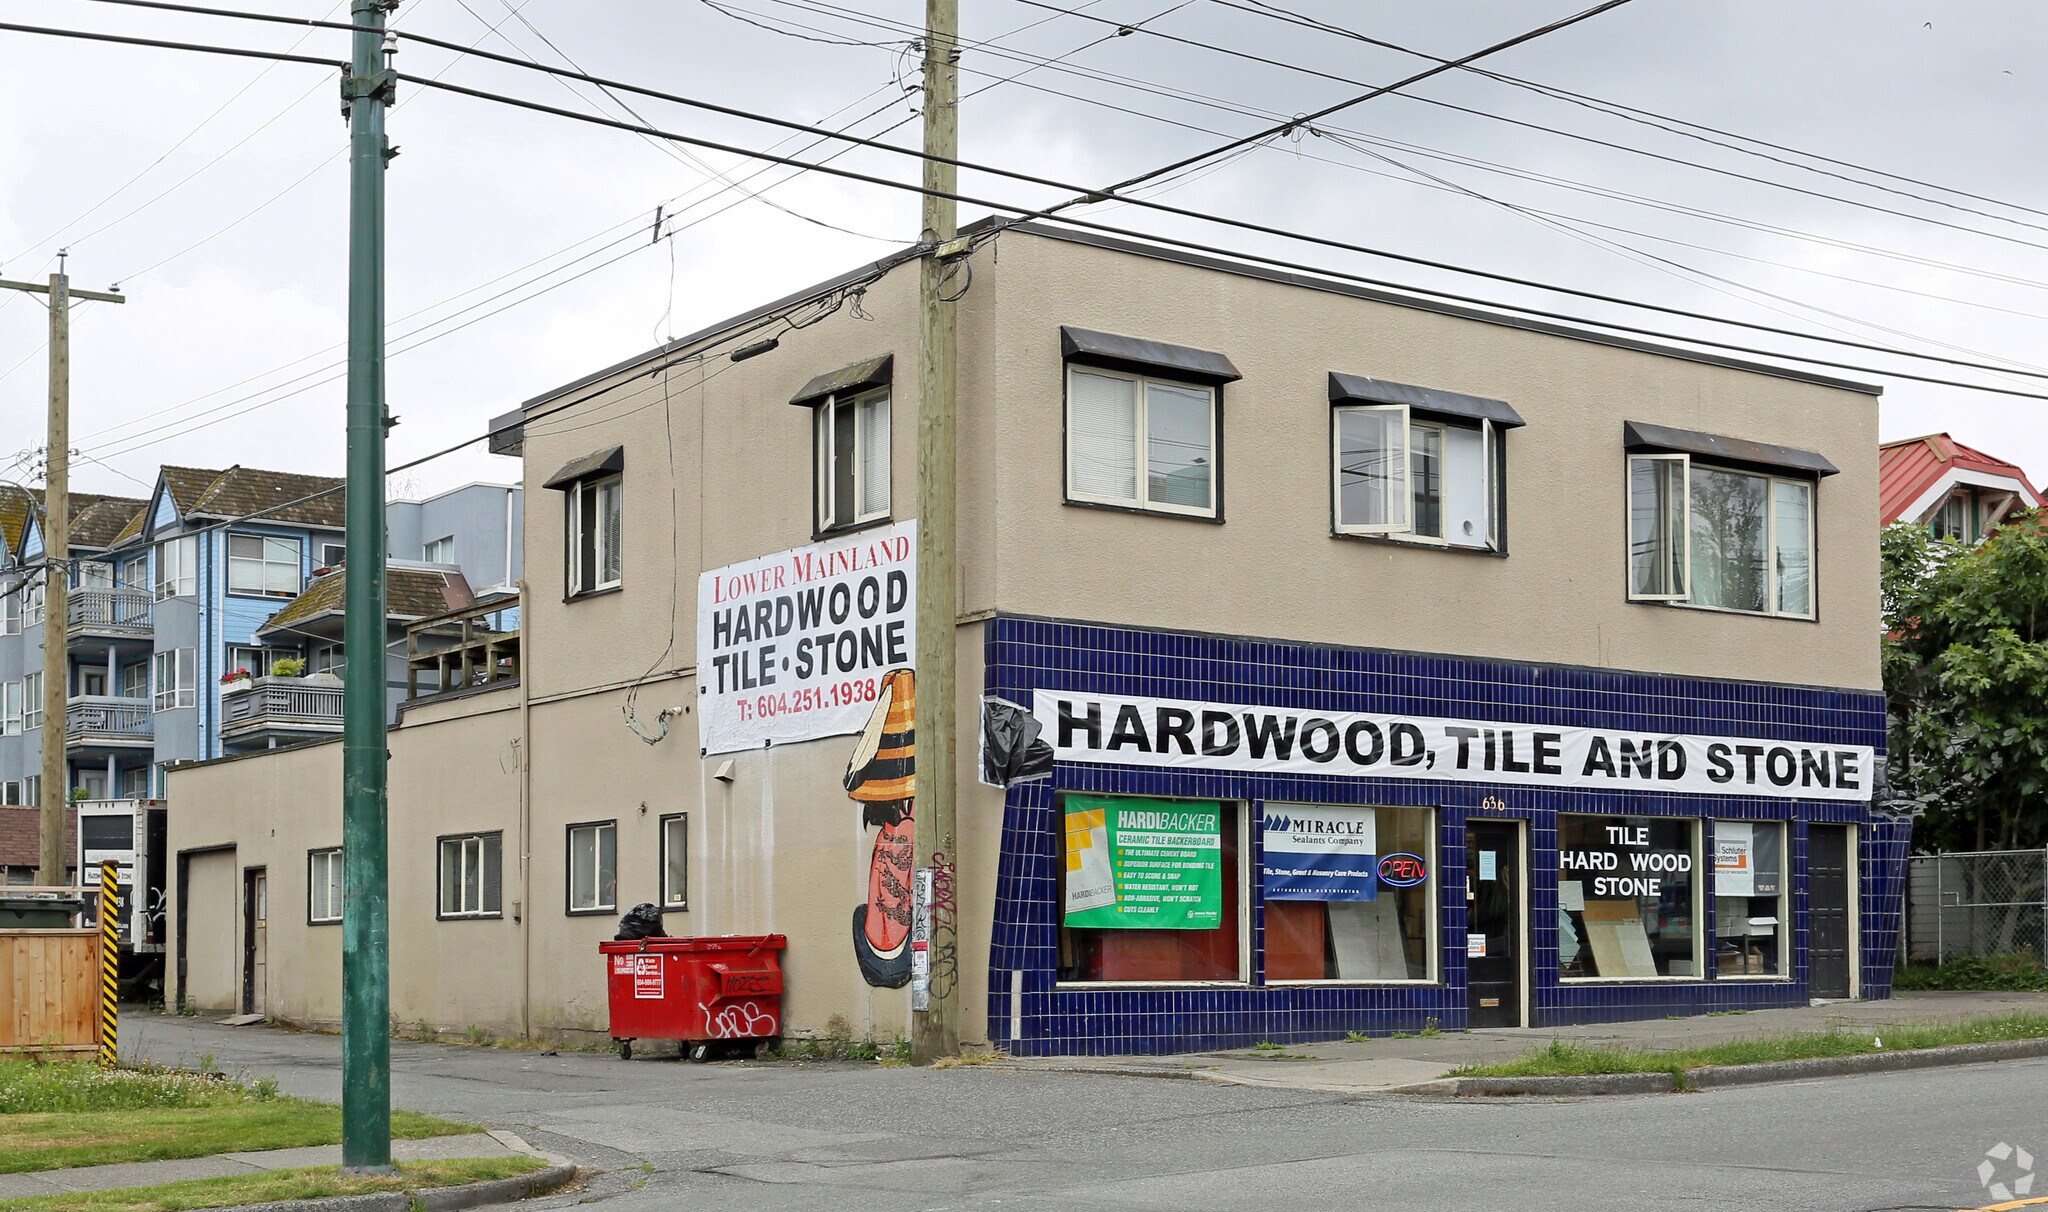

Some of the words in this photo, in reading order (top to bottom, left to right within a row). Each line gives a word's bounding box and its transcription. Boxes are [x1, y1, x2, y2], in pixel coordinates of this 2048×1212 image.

[714, 565, 785, 604] LOWER
[792, 536, 910, 585] MAINLAND
[713, 569, 907, 649] HARDWOOD
[737, 699, 753, 721] T:
[758, 678, 876, 719] 604.251.1938
[1057, 700, 1436, 771] HARDWOOD,
[1445, 726, 1561, 775] TILE
[1582, 735, 1687, 780] AND
[1707, 743, 1859, 790] STONE
[1482, 795, 1506, 811] 636
[1118, 811, 1216, 832] HARDIBACKER
[1293, 819, 1364, 834] MIRACLE
[1119, 834, 1150, 845] CERAMIC
[1152, 835, 1166, 845] TILE
[1167, 836, 1215, 846] BACKERBOARD
[1292, 835, 1326, 844] Sealants
[1327, 836, 1364, 846] Company
[1605, 826, 1649, 846] TILE
[1135, 849, 1159, 857] ULTIMATE
[1560, 851, 1618, 870] HARD
[1629, 853, 1692, 872] WOOD
[1275, 868, 1292, 876] Stone,
[1380, 860, 1425, 878] OPEN
[1072, 885, 1112, 900] HARDIBACKER
[1594, 877, 1661, 896] STONE
